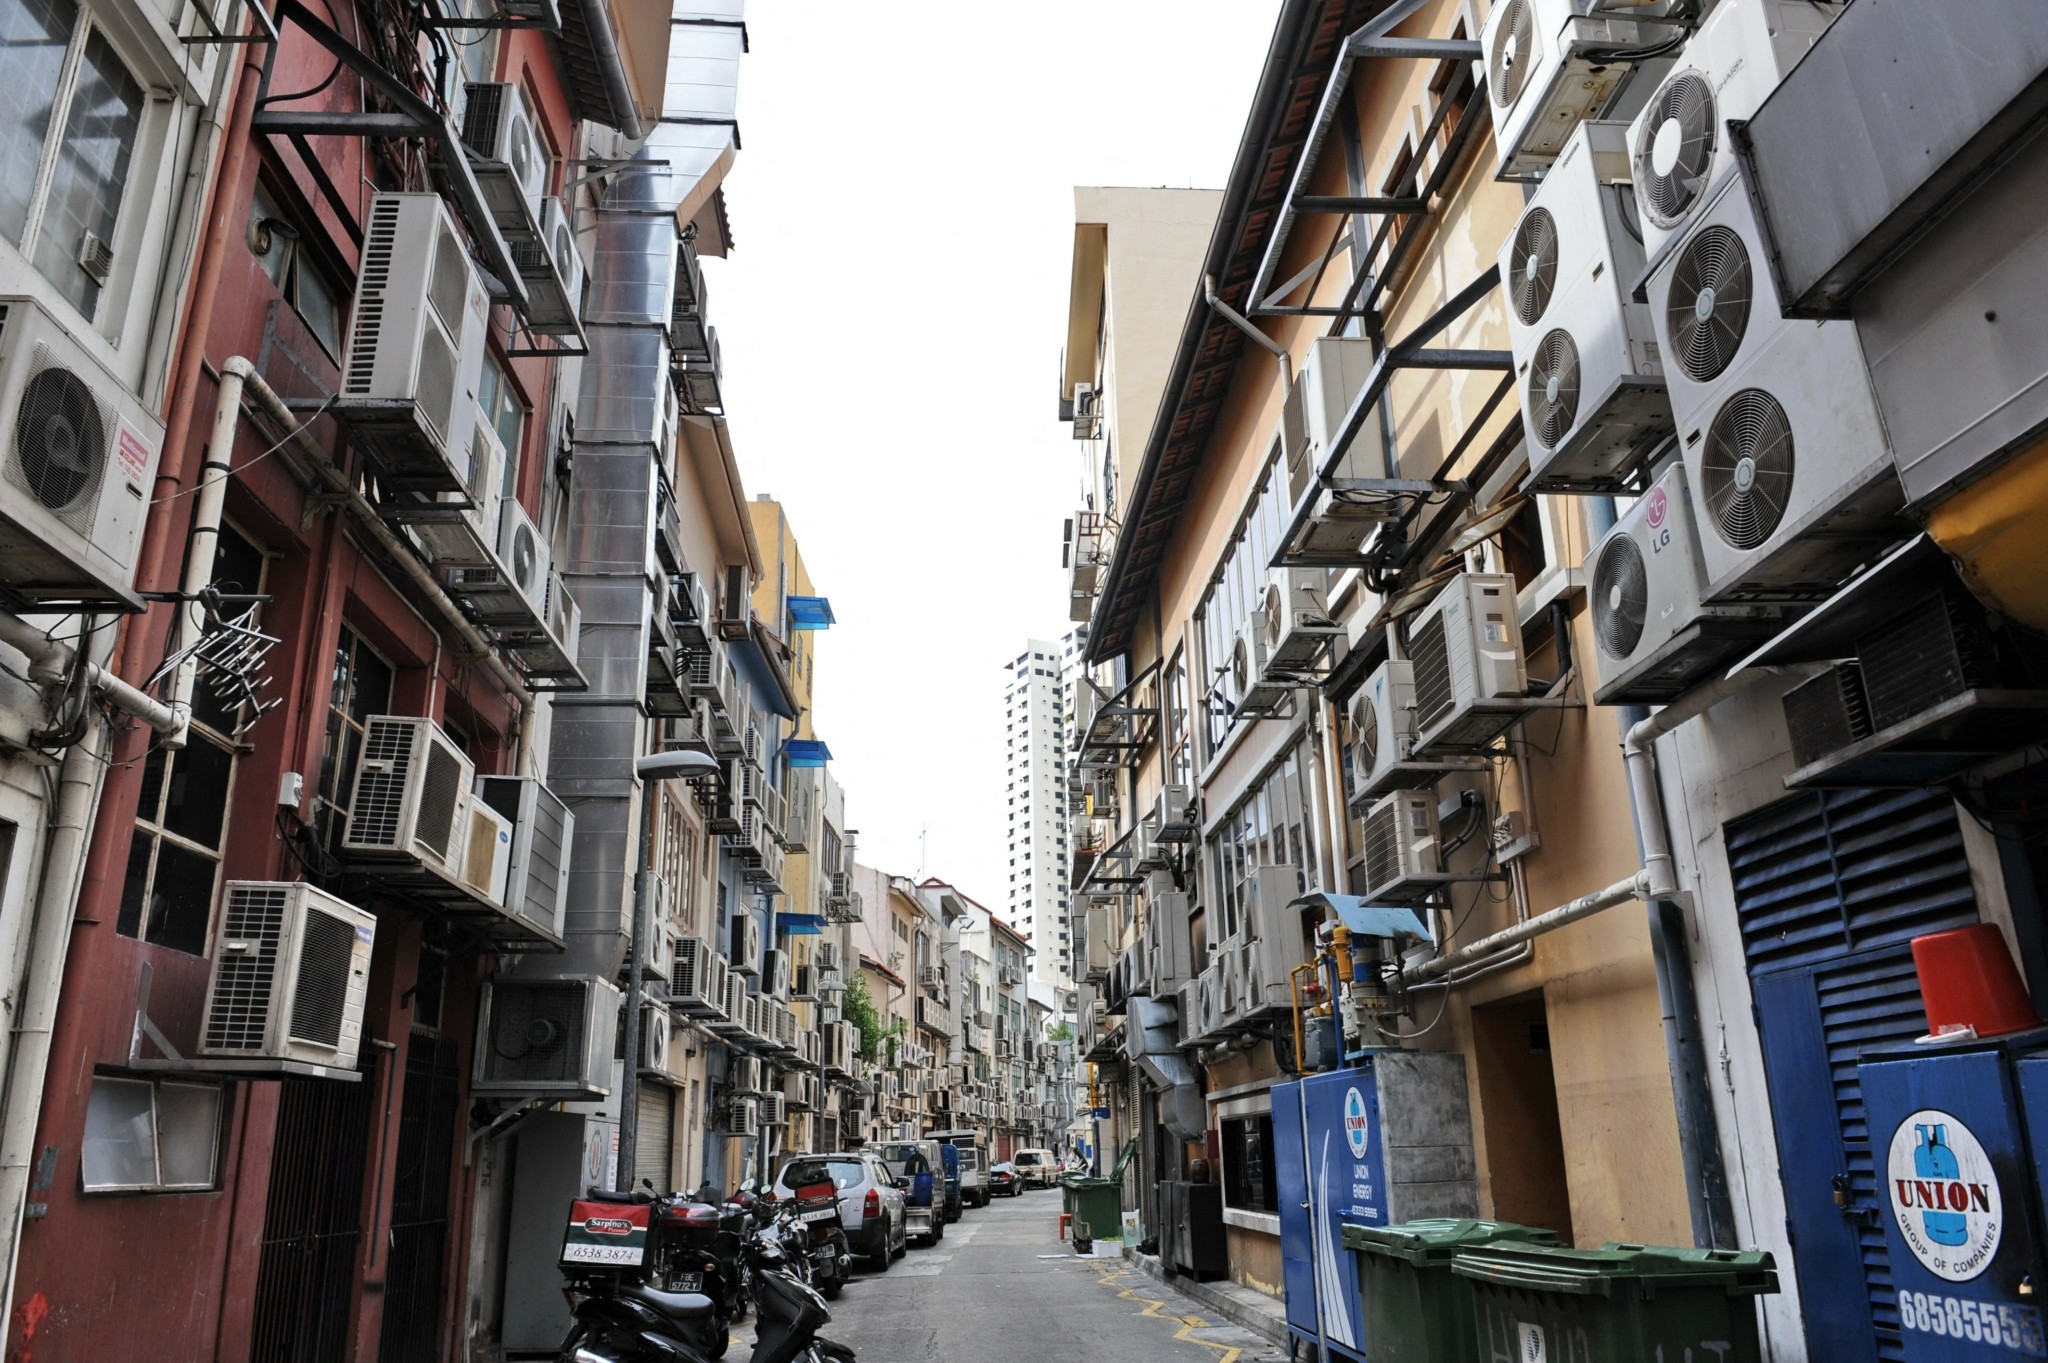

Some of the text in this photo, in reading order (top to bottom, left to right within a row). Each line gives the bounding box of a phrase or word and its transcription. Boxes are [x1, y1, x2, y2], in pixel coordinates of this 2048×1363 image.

[1652, 529, 1671, 554] LG
[1347, 1116, 1366, 1130] UNION
[1354, 1164, 1369, 1179] UNION
[1352, 1183, 1373, 1200] ENERGY
[1896, 1179, 1991, 1214] UNION
[591, 1218, 628, 1228] Sarpino's
[1900, 1213, 1997, 1274] GROUP OF COMPANIES
[573, 1247, 634, 1260] 6538 3874
[692, 1282, 698, 1290] Y
[1898, 1289, 2042, 1353] 68585555
